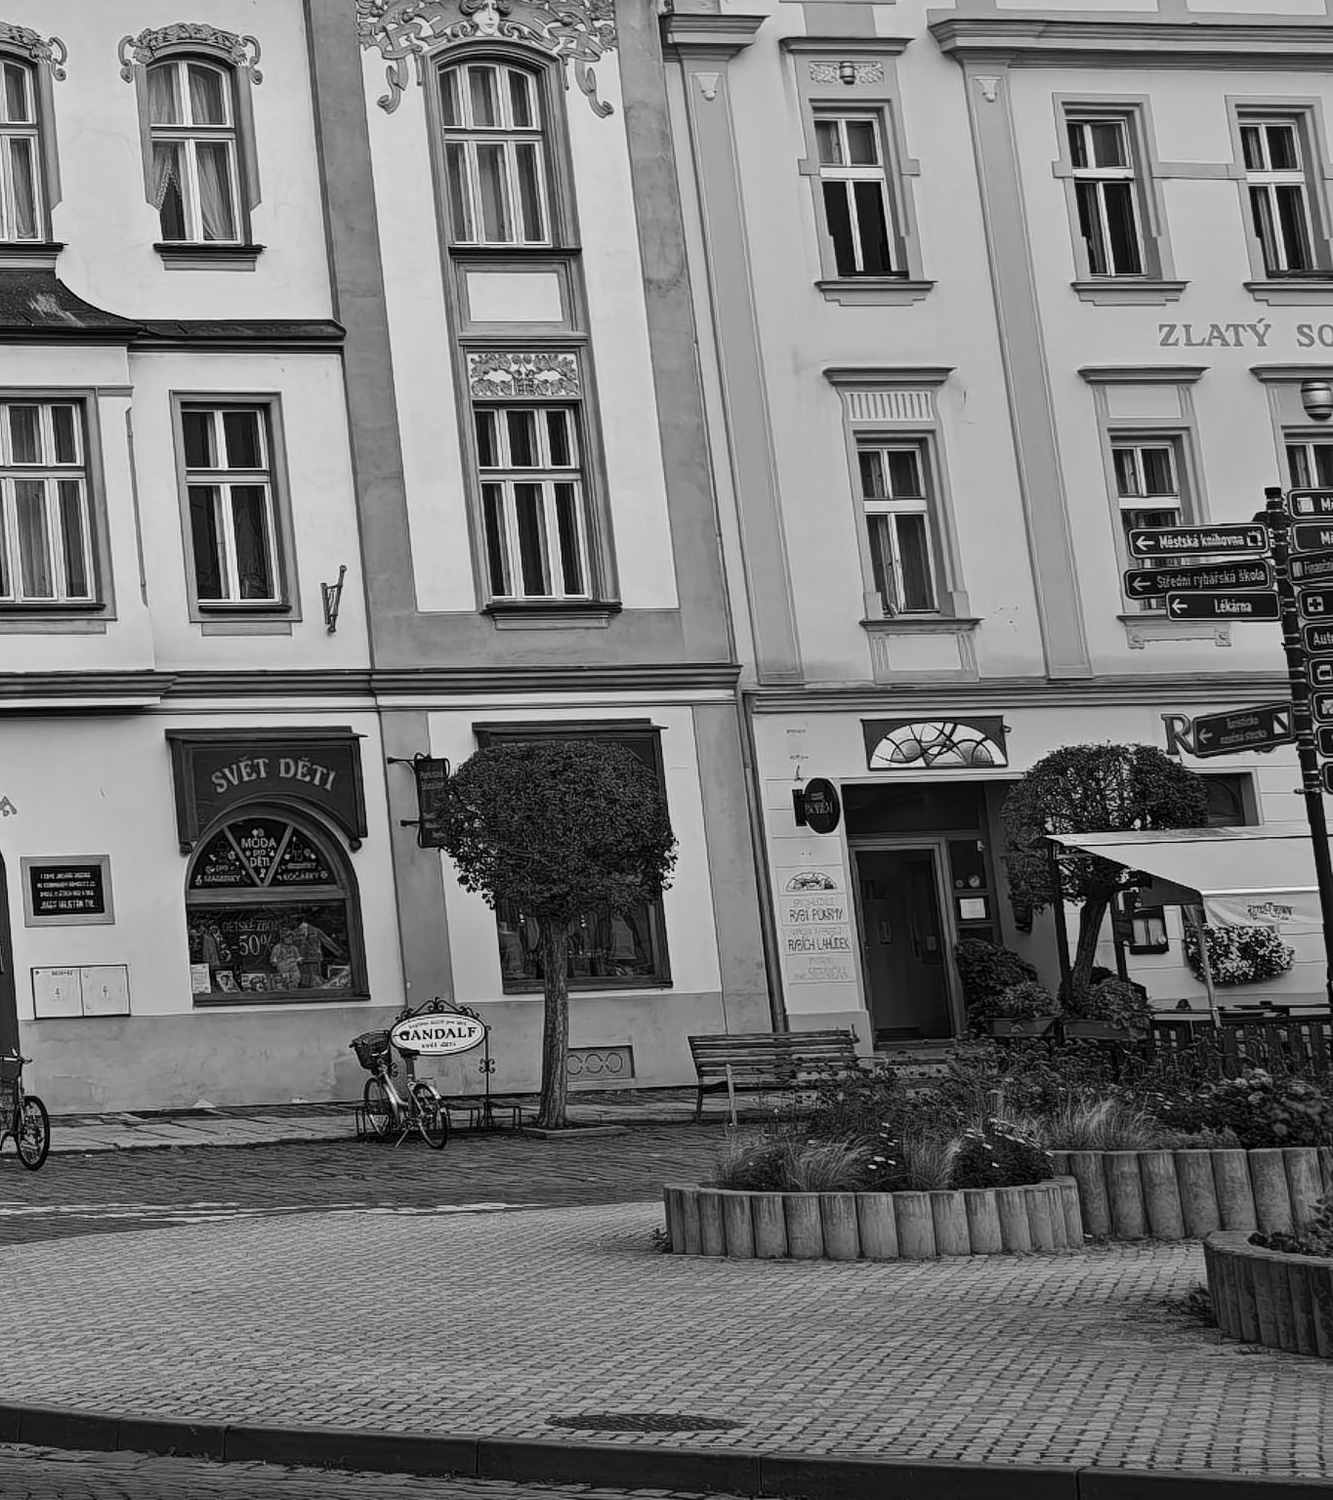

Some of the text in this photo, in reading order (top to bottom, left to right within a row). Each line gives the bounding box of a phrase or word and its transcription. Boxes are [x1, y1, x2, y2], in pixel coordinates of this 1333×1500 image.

[1158, 317, 1272, 348] ZLATÝ
[1159, 532, 1244, 548] Městská knihovna
[1157, 568, 1265, 588] Střední rybářská škola
[1213, 598, 1252, 614] Lékárna
[212, 754, 269, 793] SVĚT
[399, 1026, 478, 1041] GANDALF
